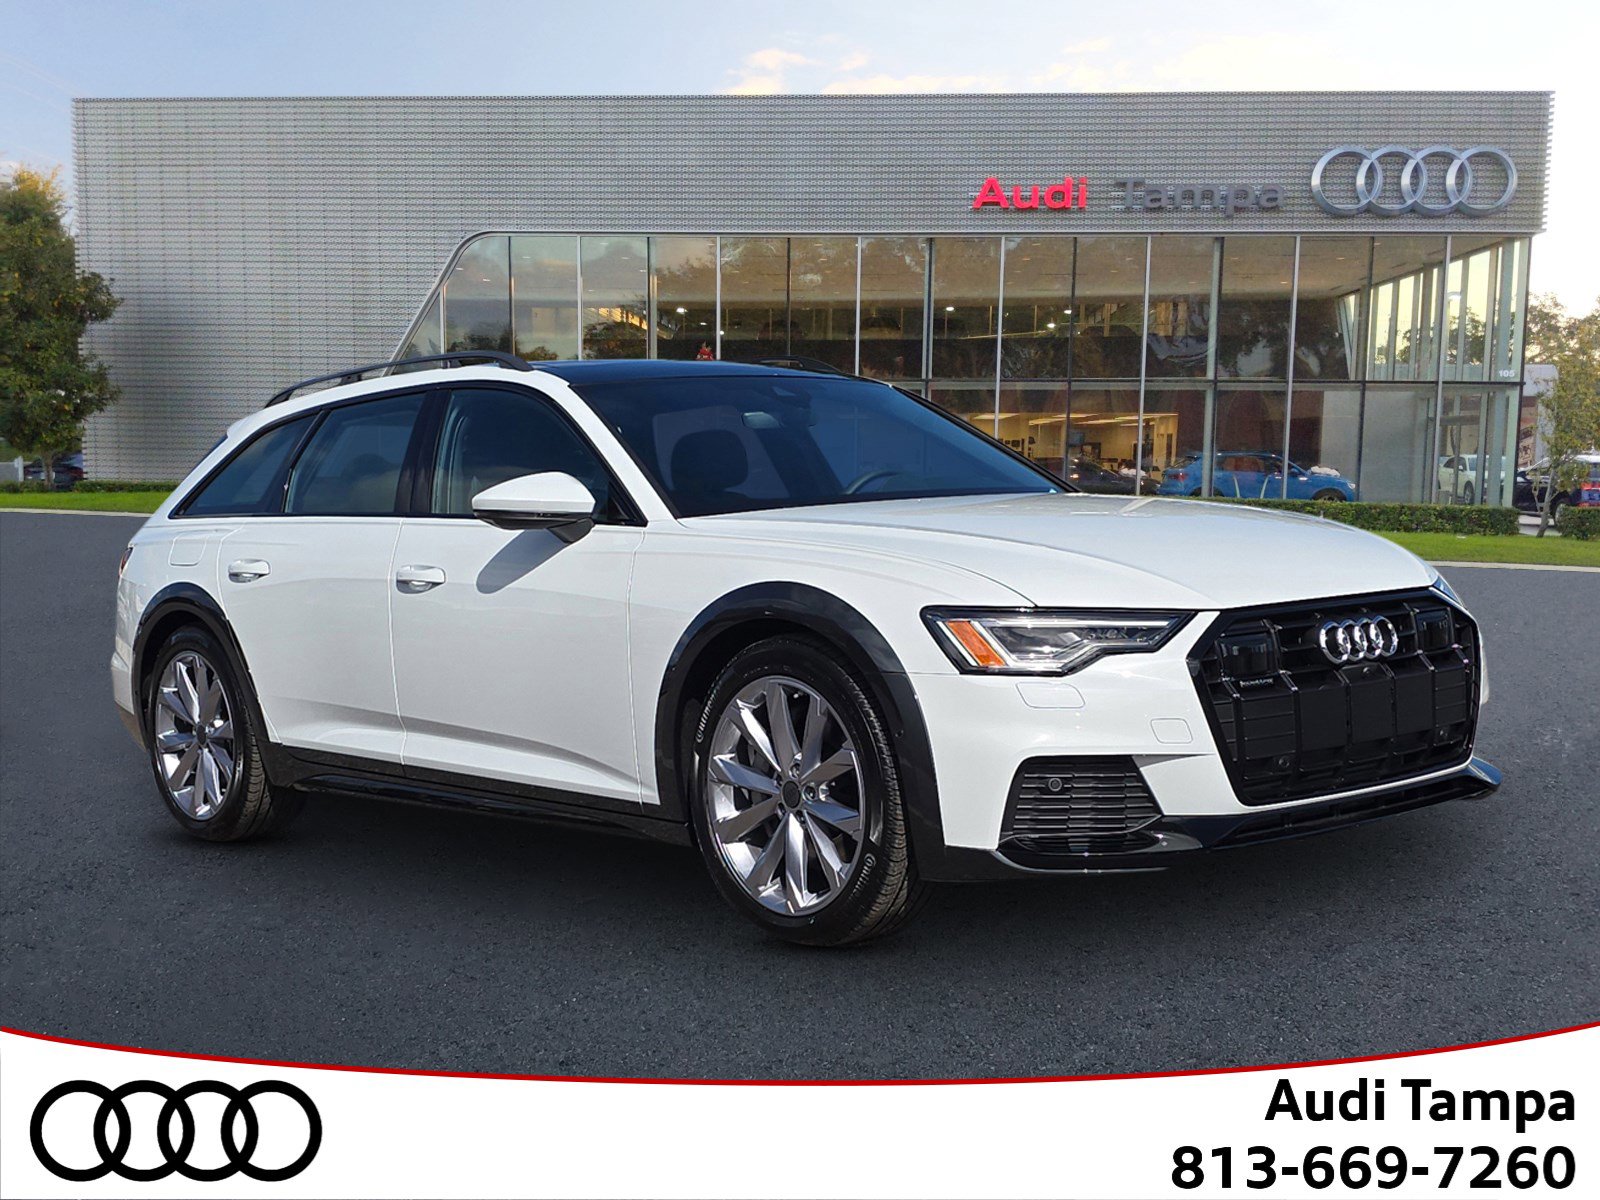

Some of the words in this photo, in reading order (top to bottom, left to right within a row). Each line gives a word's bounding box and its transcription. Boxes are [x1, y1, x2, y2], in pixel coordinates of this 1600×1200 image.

[971, 176, 1088, 210] Audi
[1114, 177, 1286, 218] Tampa
[1498, 369, 1515, 378] 105
